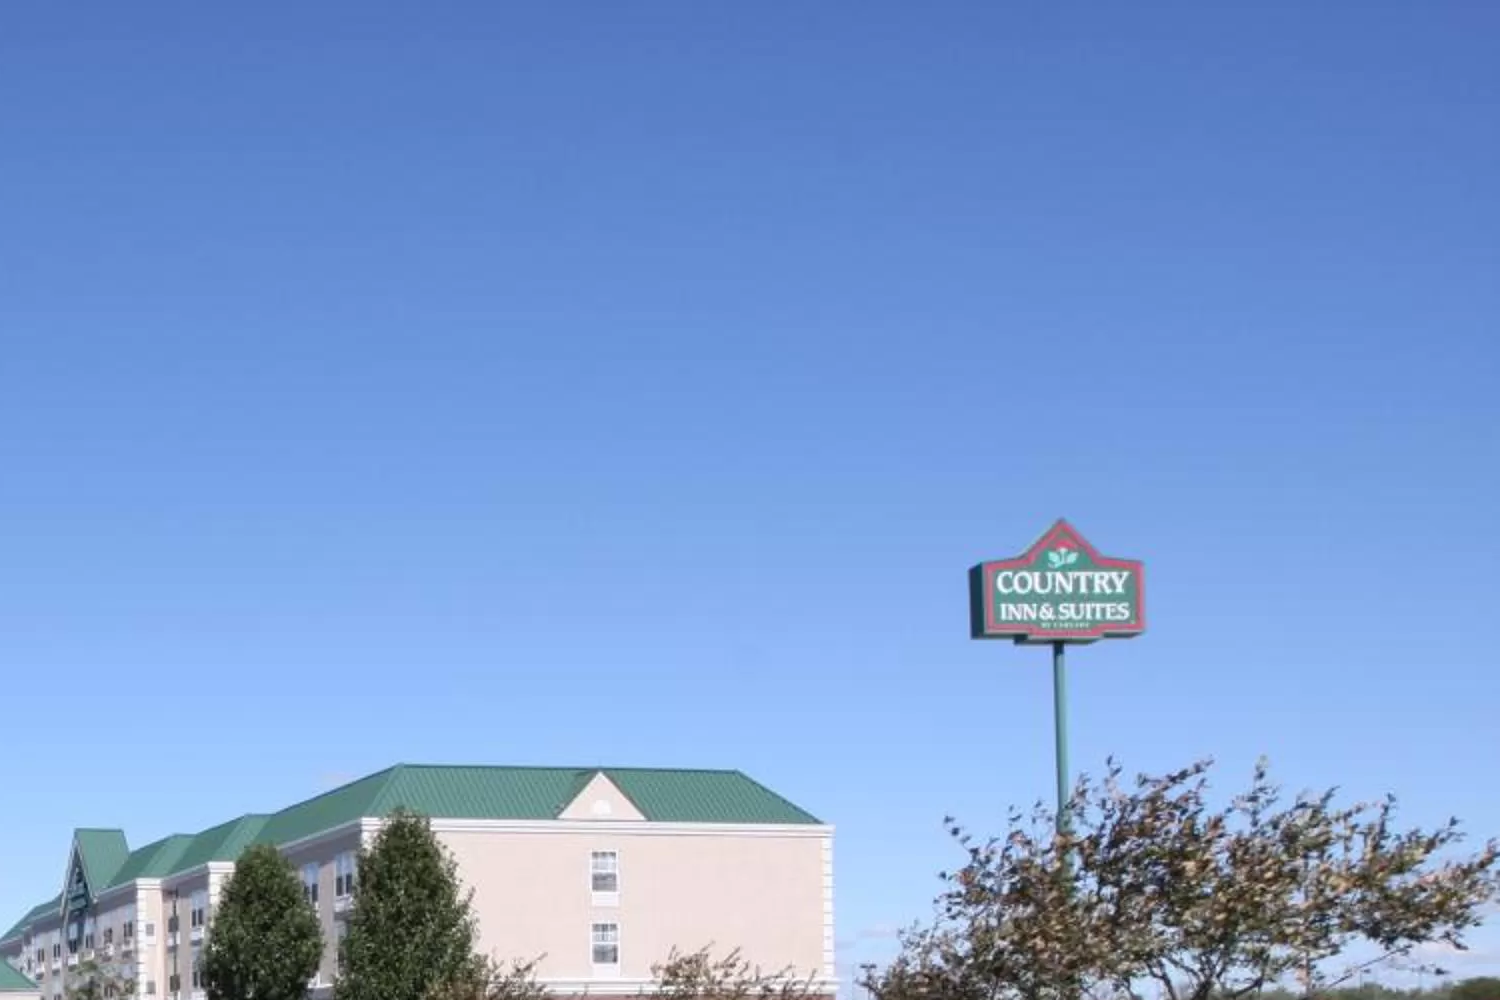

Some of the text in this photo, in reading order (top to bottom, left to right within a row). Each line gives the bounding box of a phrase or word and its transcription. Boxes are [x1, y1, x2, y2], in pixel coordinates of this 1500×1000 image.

[996, 570, 1132, 595] COUNTRY
[1000, 603, 1038, 621] INN
[1058, 602, 1131, 621] SUITES
